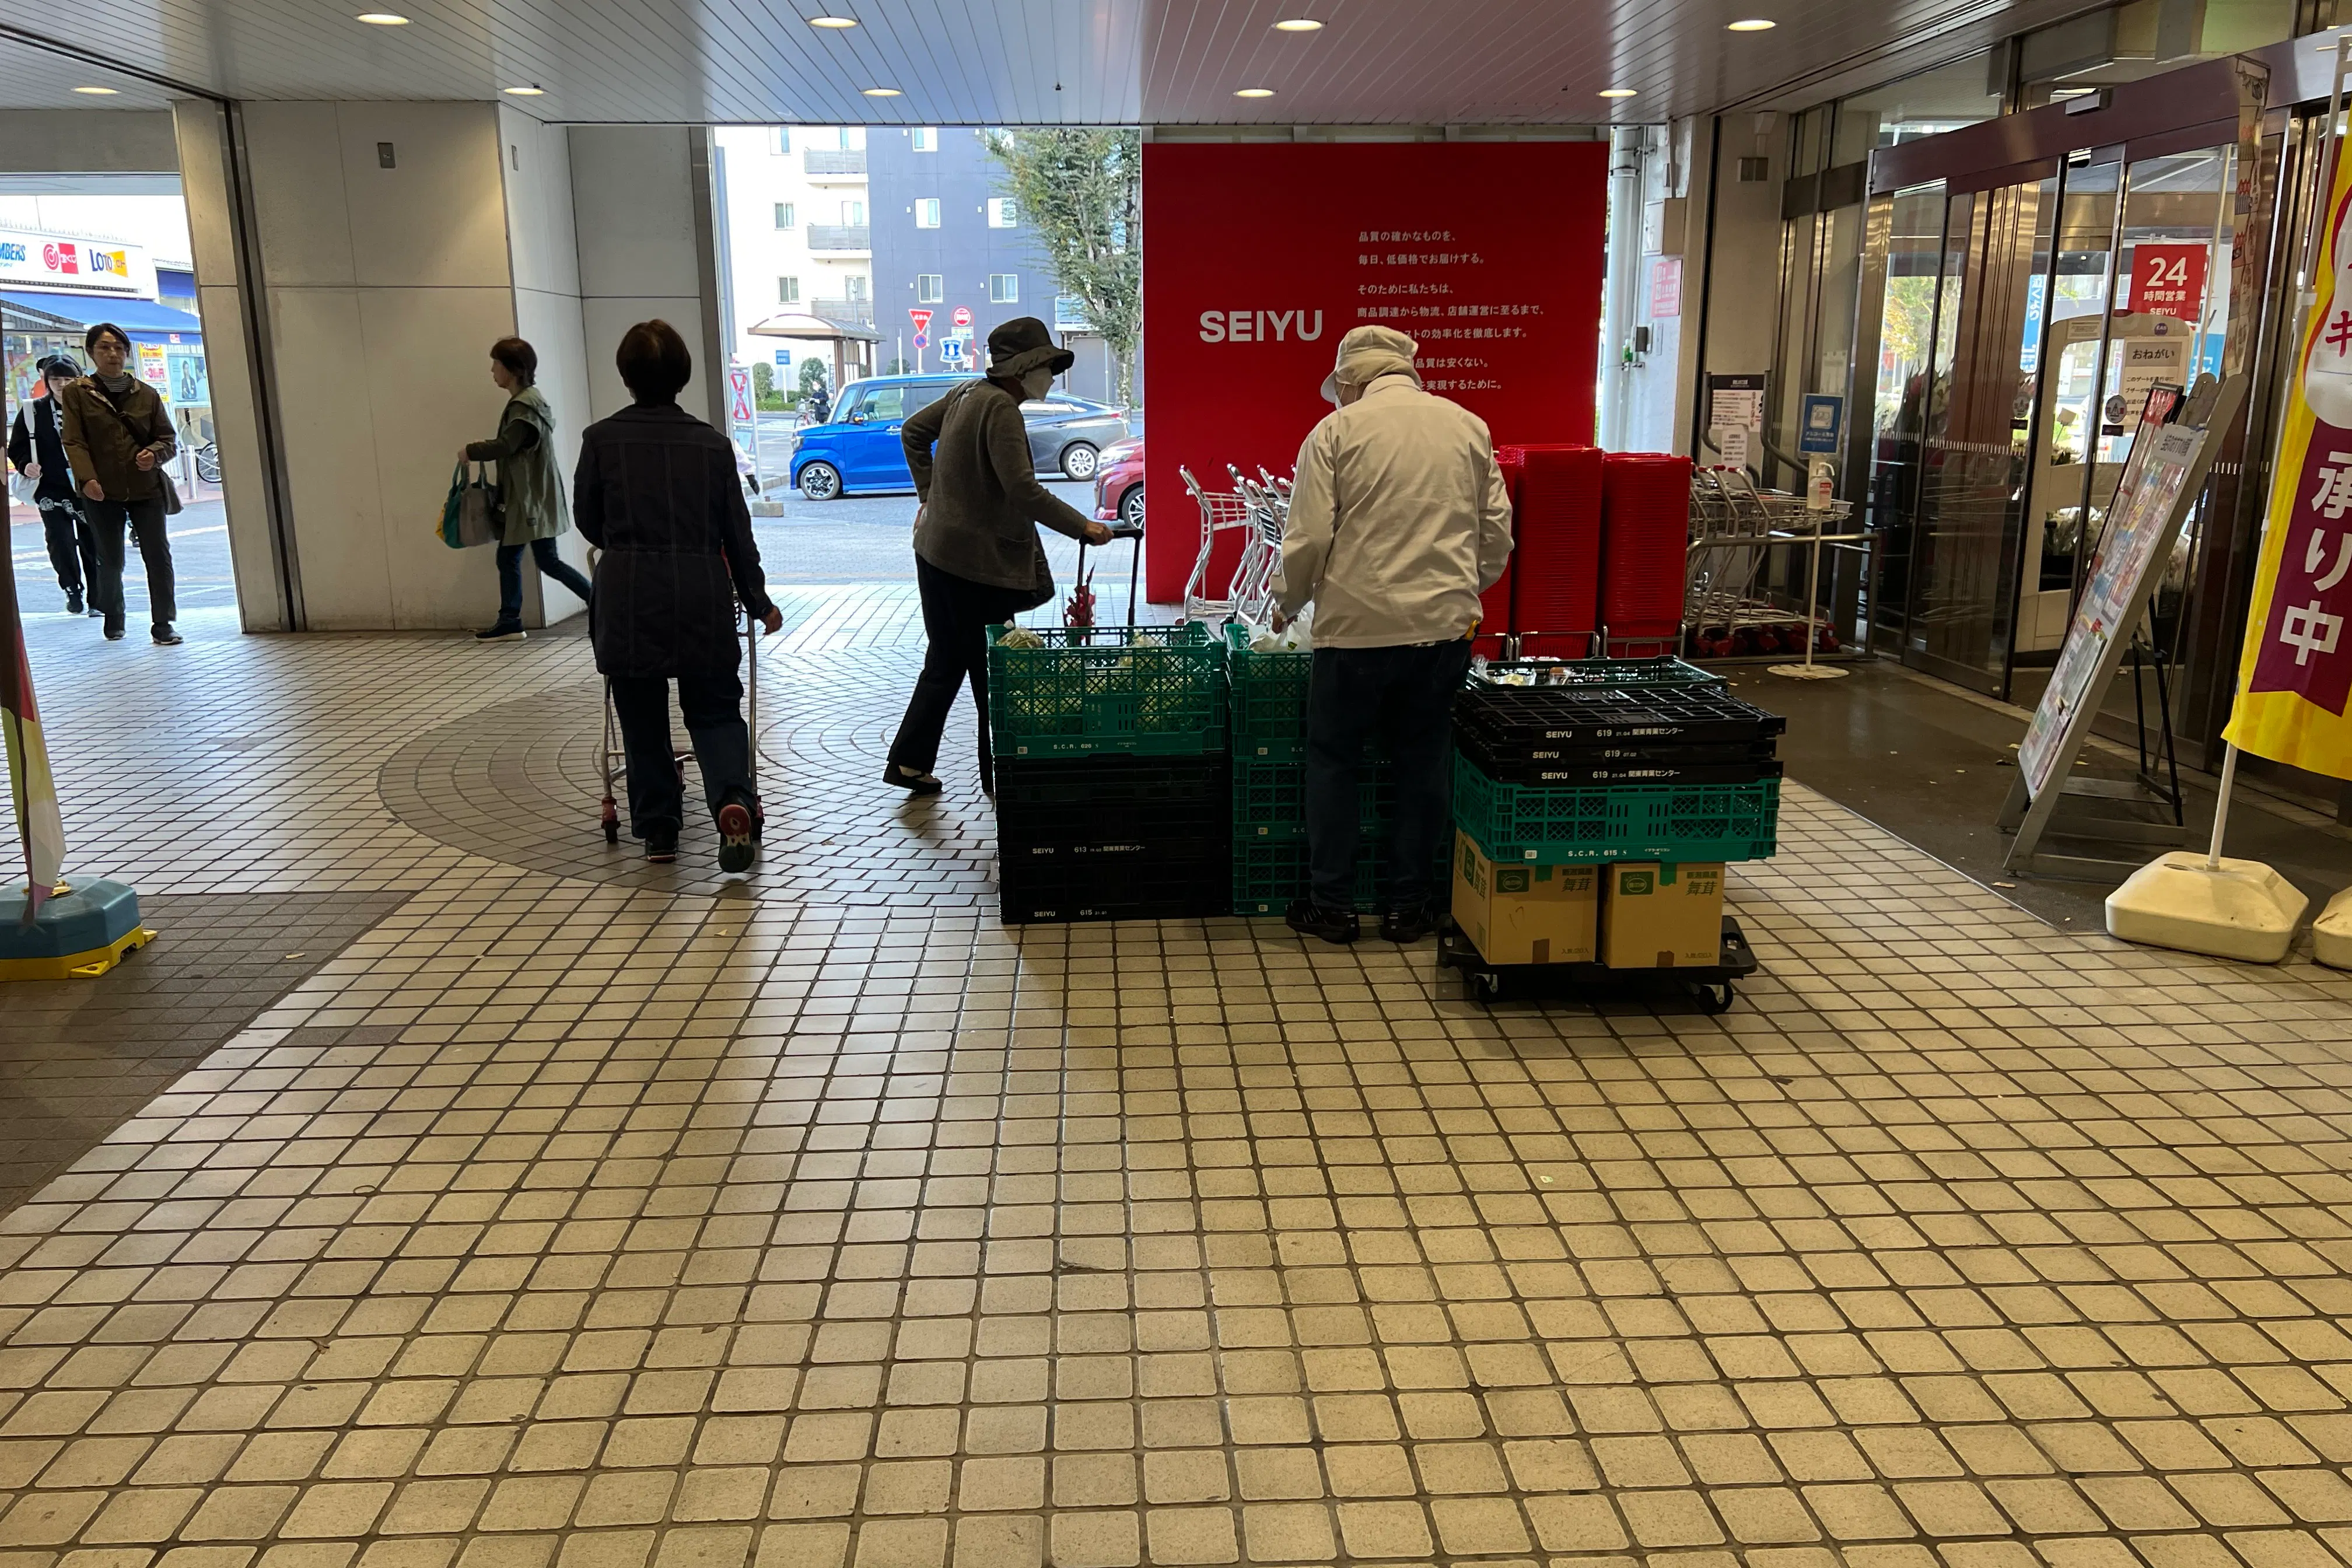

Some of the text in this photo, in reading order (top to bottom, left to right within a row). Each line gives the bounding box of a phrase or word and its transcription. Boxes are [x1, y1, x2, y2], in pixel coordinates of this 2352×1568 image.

[1359, 230, 1456, 242] 品質の確かなものを、
[89, 249, 113, 272] LOTO
[1359, 253, 1484, 265] 毎日、低価格でお届けする。
[2146, 257, 2188, 287] 24
[1357, 283, 1454, 295] そのために私たちは、
[2143, 290, 2186, 302] 時間営業
[1357, 304, 1545, 318] 商品調達から物流、店舗運営に至るまで、
[2150, 307, 2177, 316] SEIYU
[1199, 310, 1322, 343] SEIYU
[1402, 327, 1528, 340] ストの効率化を徹底します。
[2132, 349, 2175, 360] おねがい
[1413, 358, 1488, 369] 品質は安くない。
[1545, 730, 1573, 738] SEIYU
[1532, 751, 1560, 759] SEIYU
[1592, 770, 1608, 778] 619
[1561, 877, 1592, 891] 舞茸
[1685, 881, 1717, 896] 舞茸
